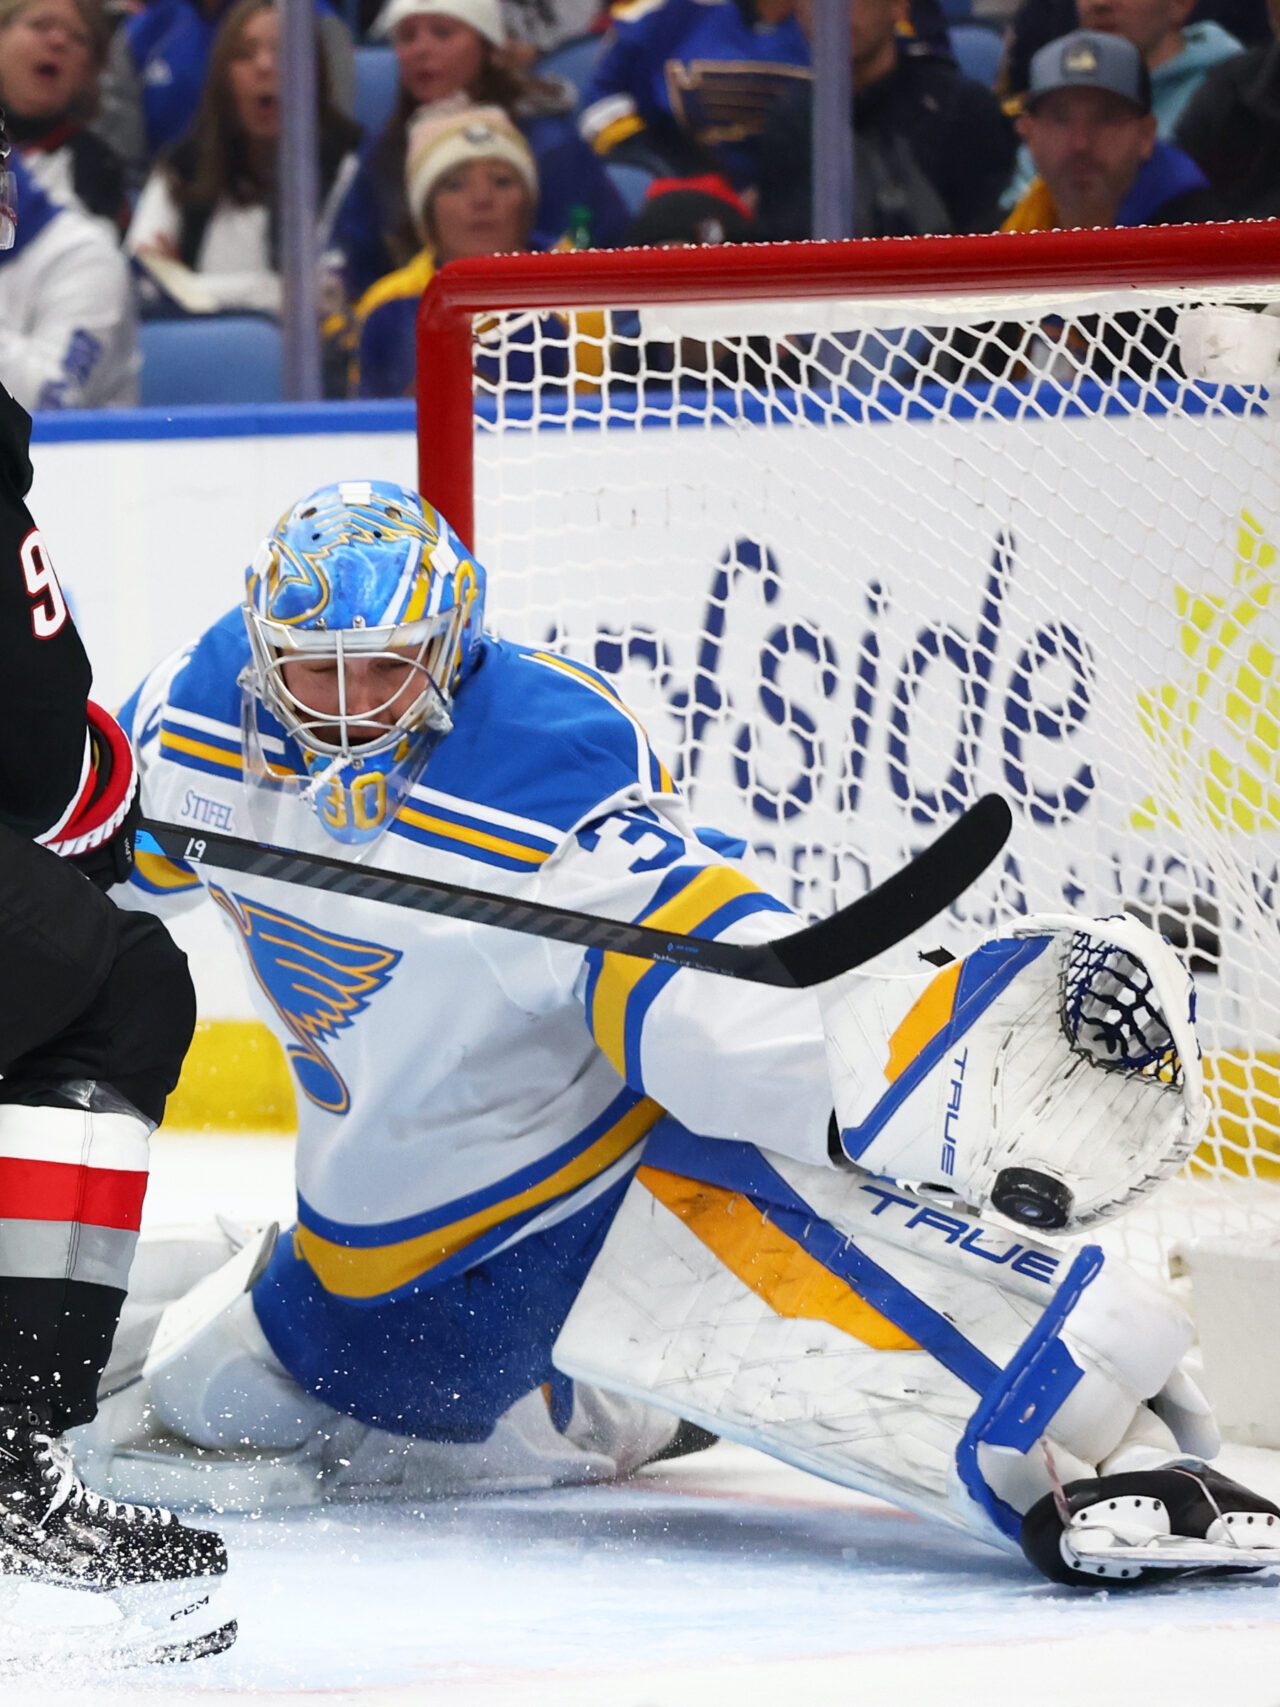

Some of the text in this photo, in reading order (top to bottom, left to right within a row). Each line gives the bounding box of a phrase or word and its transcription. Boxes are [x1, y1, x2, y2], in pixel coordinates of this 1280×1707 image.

[181, 789, 233, 832] STIFEL
[314, 771, 387, 831] 30
[941, 1047, 968, 1177] TRUE
[860, 1184, 1061, 1285] TRUE
[170, 1594, 210, 1621] CCM
